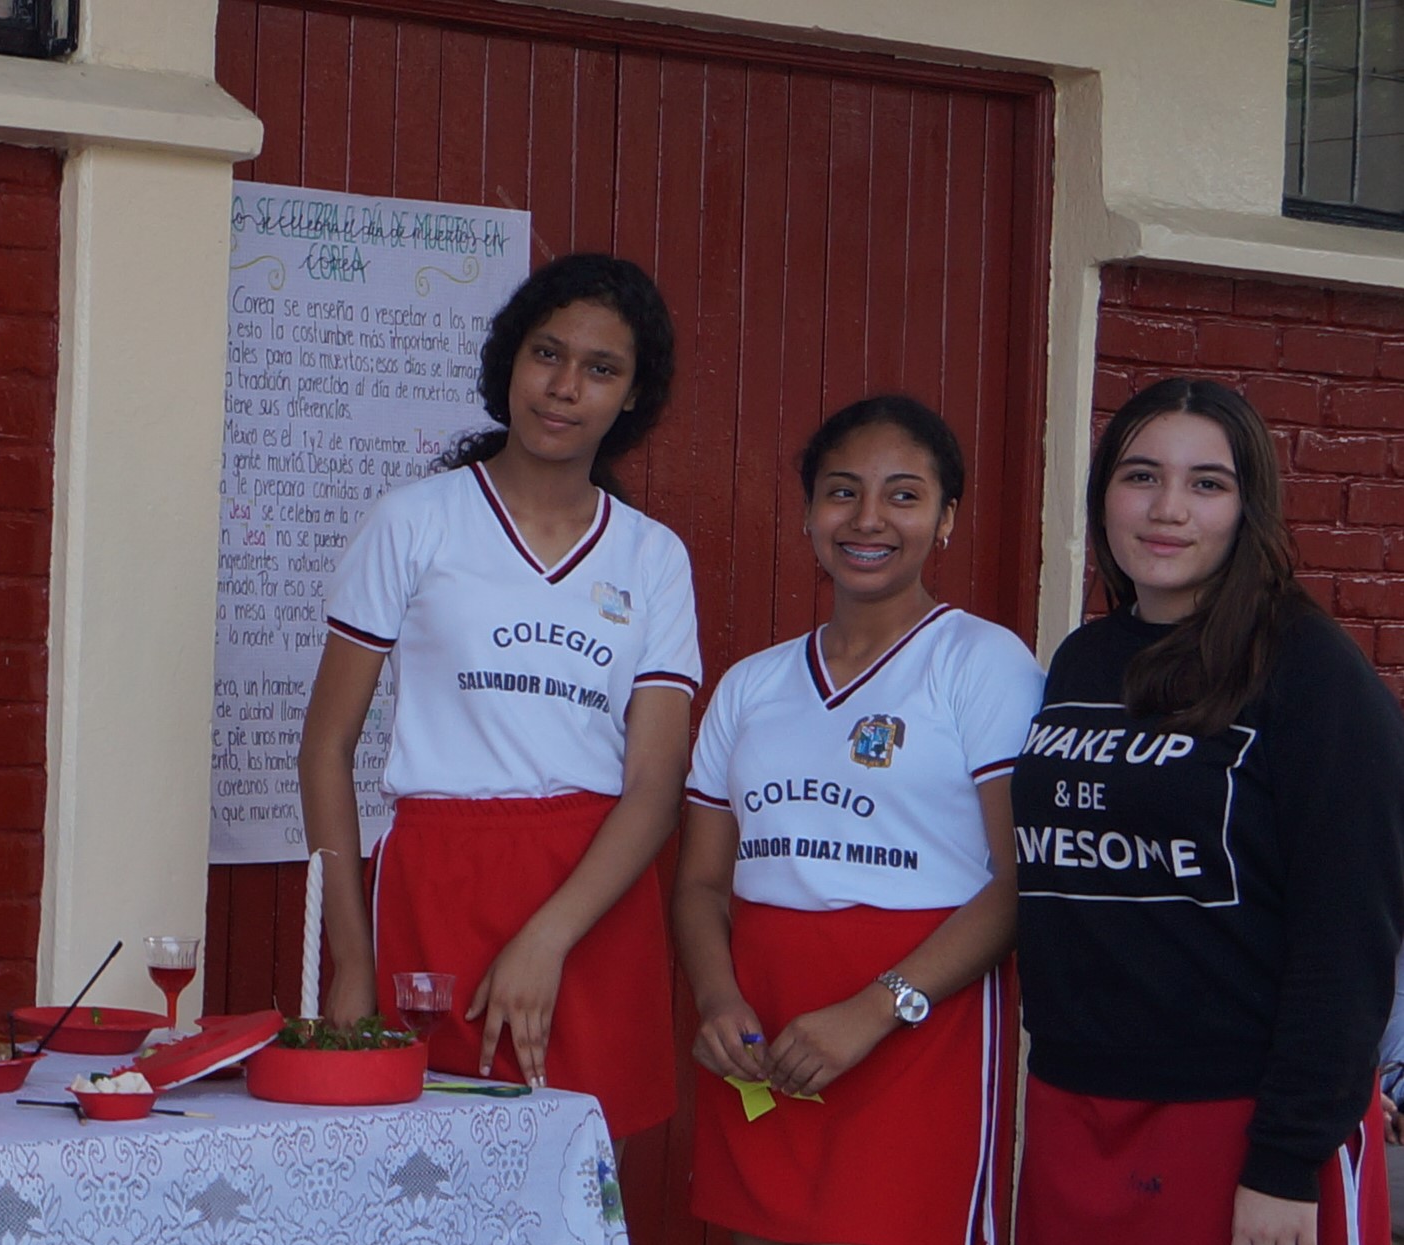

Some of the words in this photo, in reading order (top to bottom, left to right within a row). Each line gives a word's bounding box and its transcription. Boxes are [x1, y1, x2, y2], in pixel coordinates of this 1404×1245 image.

[232, 286, 274, 314] Corea
[284, 299, 300, 318] se
[307, 300, 354, 322] enseña
[375, 304, 427, 333] respetar
[433, 312, 441, 327] a
[449, 307, 466, 329] los
[236, 318, 263, 339] esto
[292, 323, 353, 347] costumbre
[359, 330, 385, 348] más
[493, 621, 613, 668] COLEGIO
[458, 671, 540, 694] SALVADOR
[544, 678, 577, 702] DIAZ
[1022, 722, 1126, 763] WAKE
[1124, 733, 1195, 766] UP
[743, 778, 876, 818] COLEGIO
[1054, 780, 1070, 808] &
[1077, 781, 1107, 811] BE
[796, 836, 842, 861] DIAZ
[845, 843, 919, 870] MIRON
